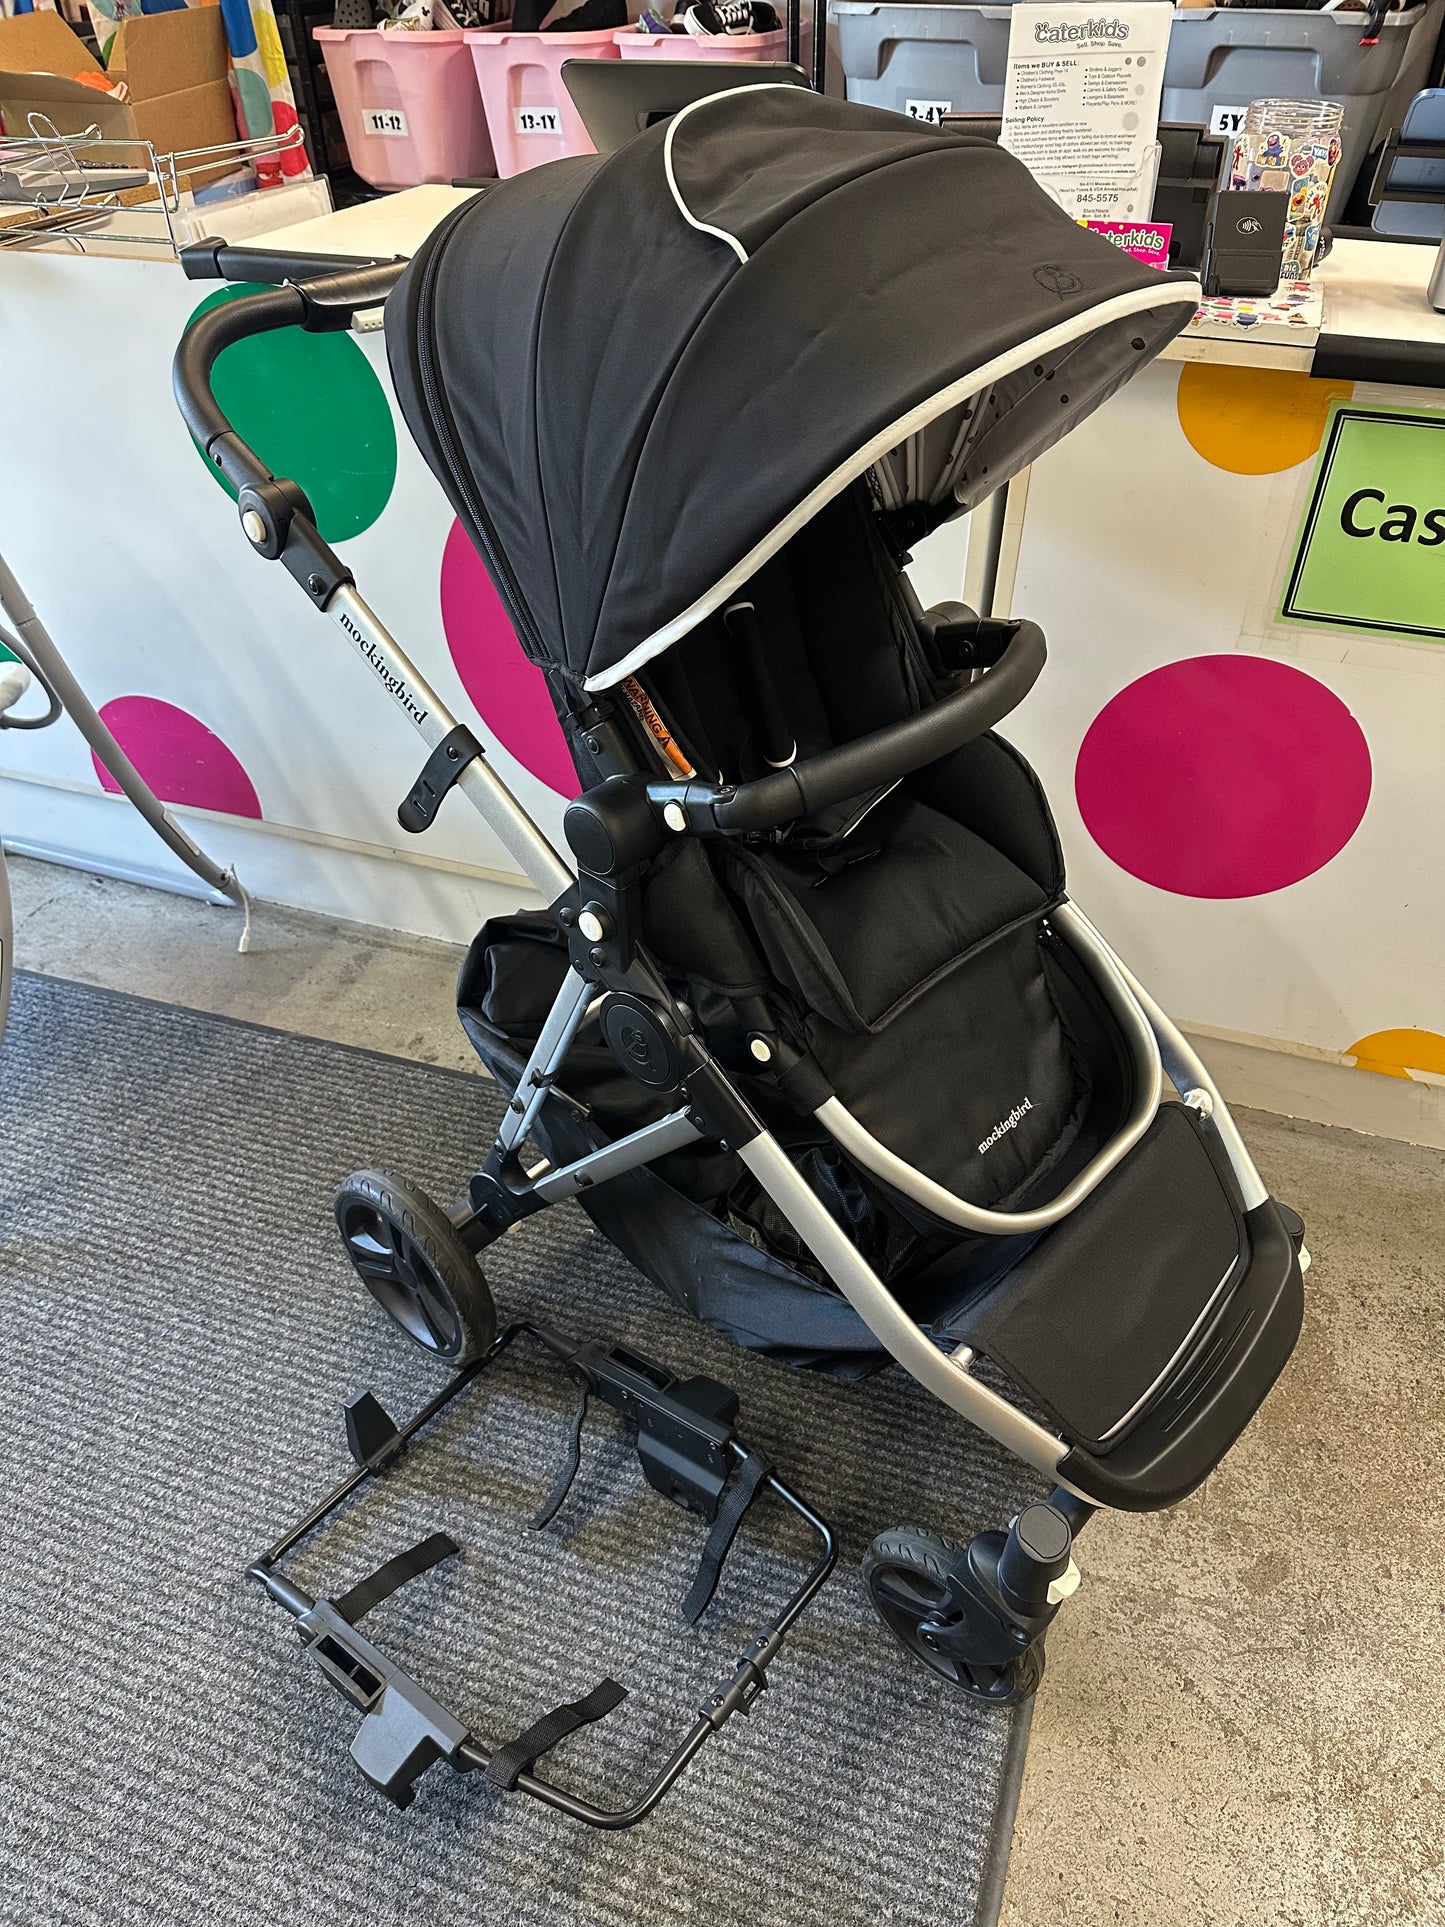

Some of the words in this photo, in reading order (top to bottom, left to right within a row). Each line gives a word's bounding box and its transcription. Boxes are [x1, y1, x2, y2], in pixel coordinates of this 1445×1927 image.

[372, 115, 401, 130] 11-12
[520, 114, 556, 130] 13-1Y
[1077, 194, 1119, 202] 845-5575
[339, 613, 429, 726] mockingbird
[624, 676, 664, 734] WARNING
[977, 1096, 1033, 1155] mockingbird
